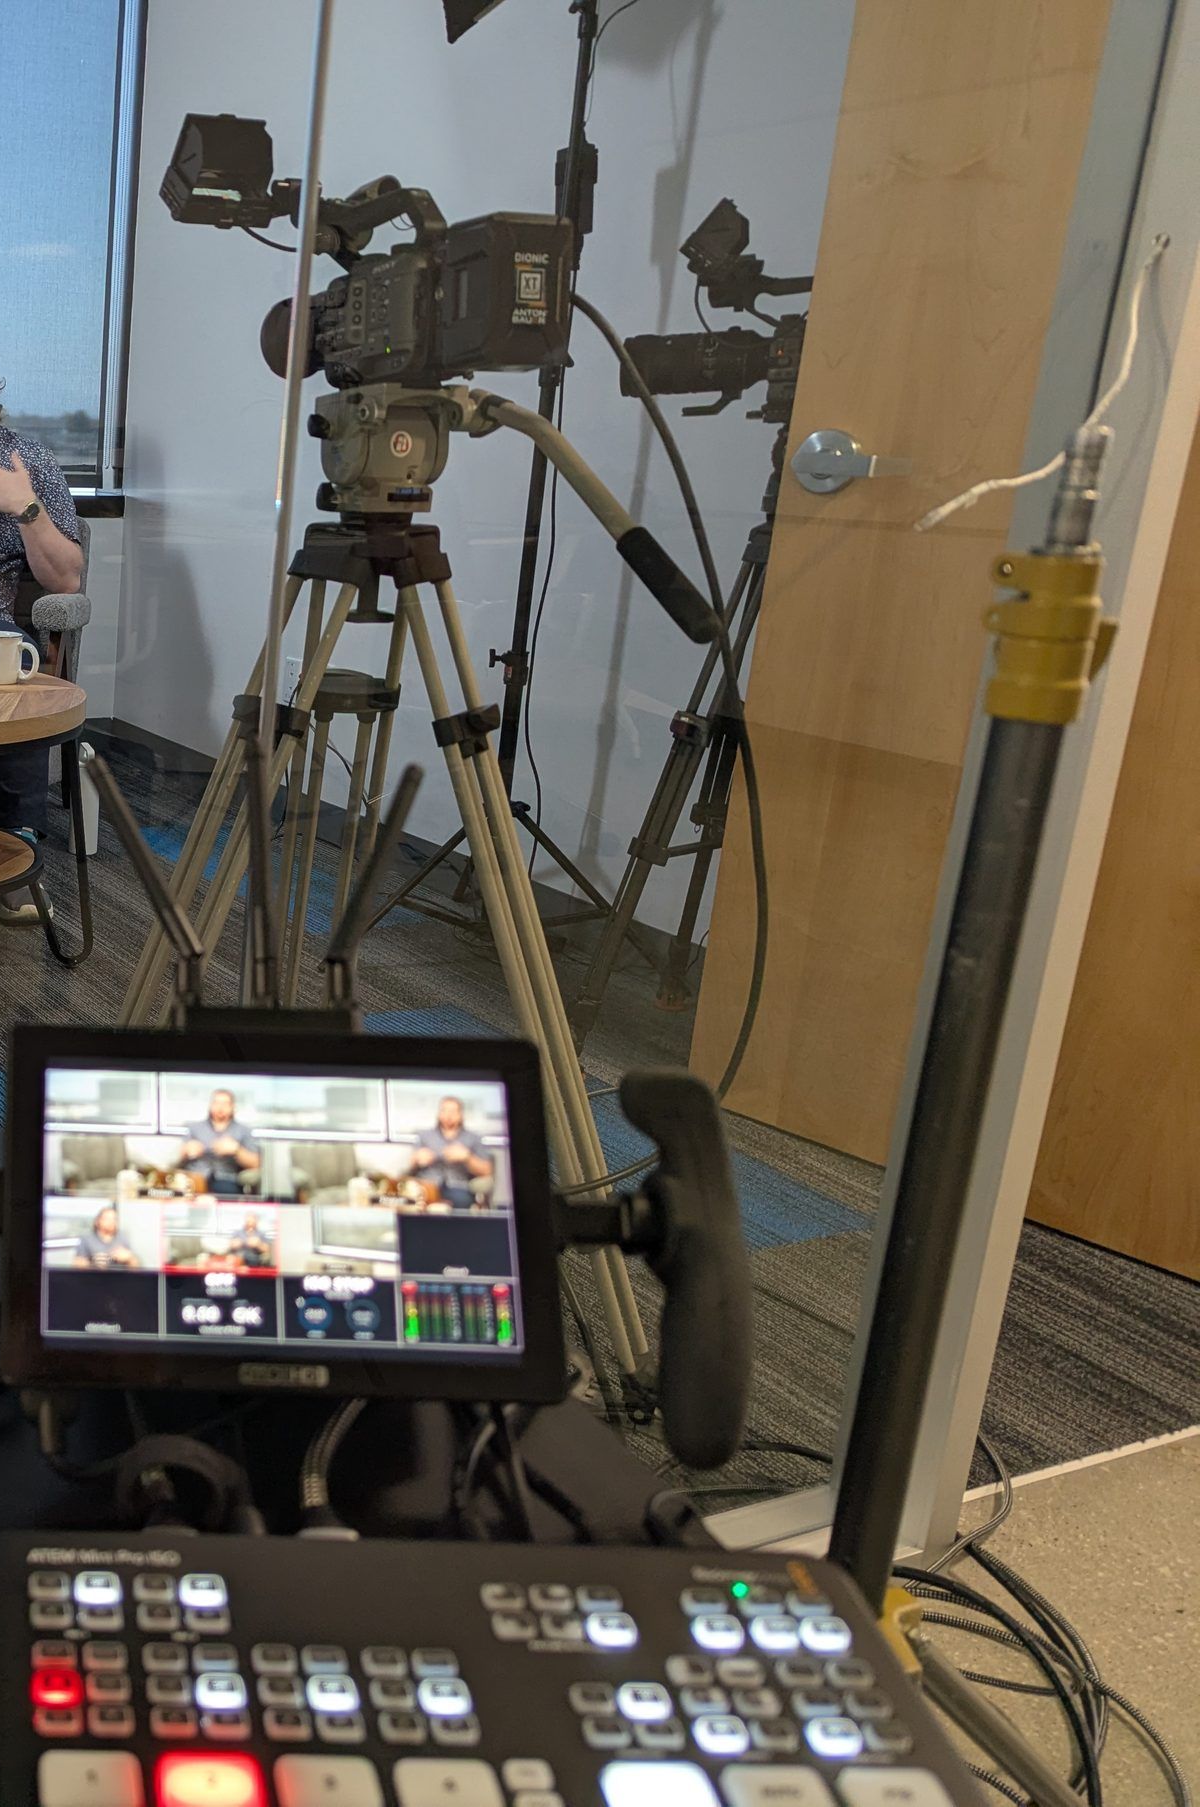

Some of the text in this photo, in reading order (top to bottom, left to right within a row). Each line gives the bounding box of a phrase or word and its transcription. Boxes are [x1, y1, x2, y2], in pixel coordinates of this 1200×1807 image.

[514, 252, 549, 263] DIONIC
[524, 277, 537, 290] XT
[513, 308, 547, 317] ANTON
[26, 1548, 75, 1565] ATEM
[79, 1548, 113, 1565] Mini
[116, 1548, 146, 1566] Pro
